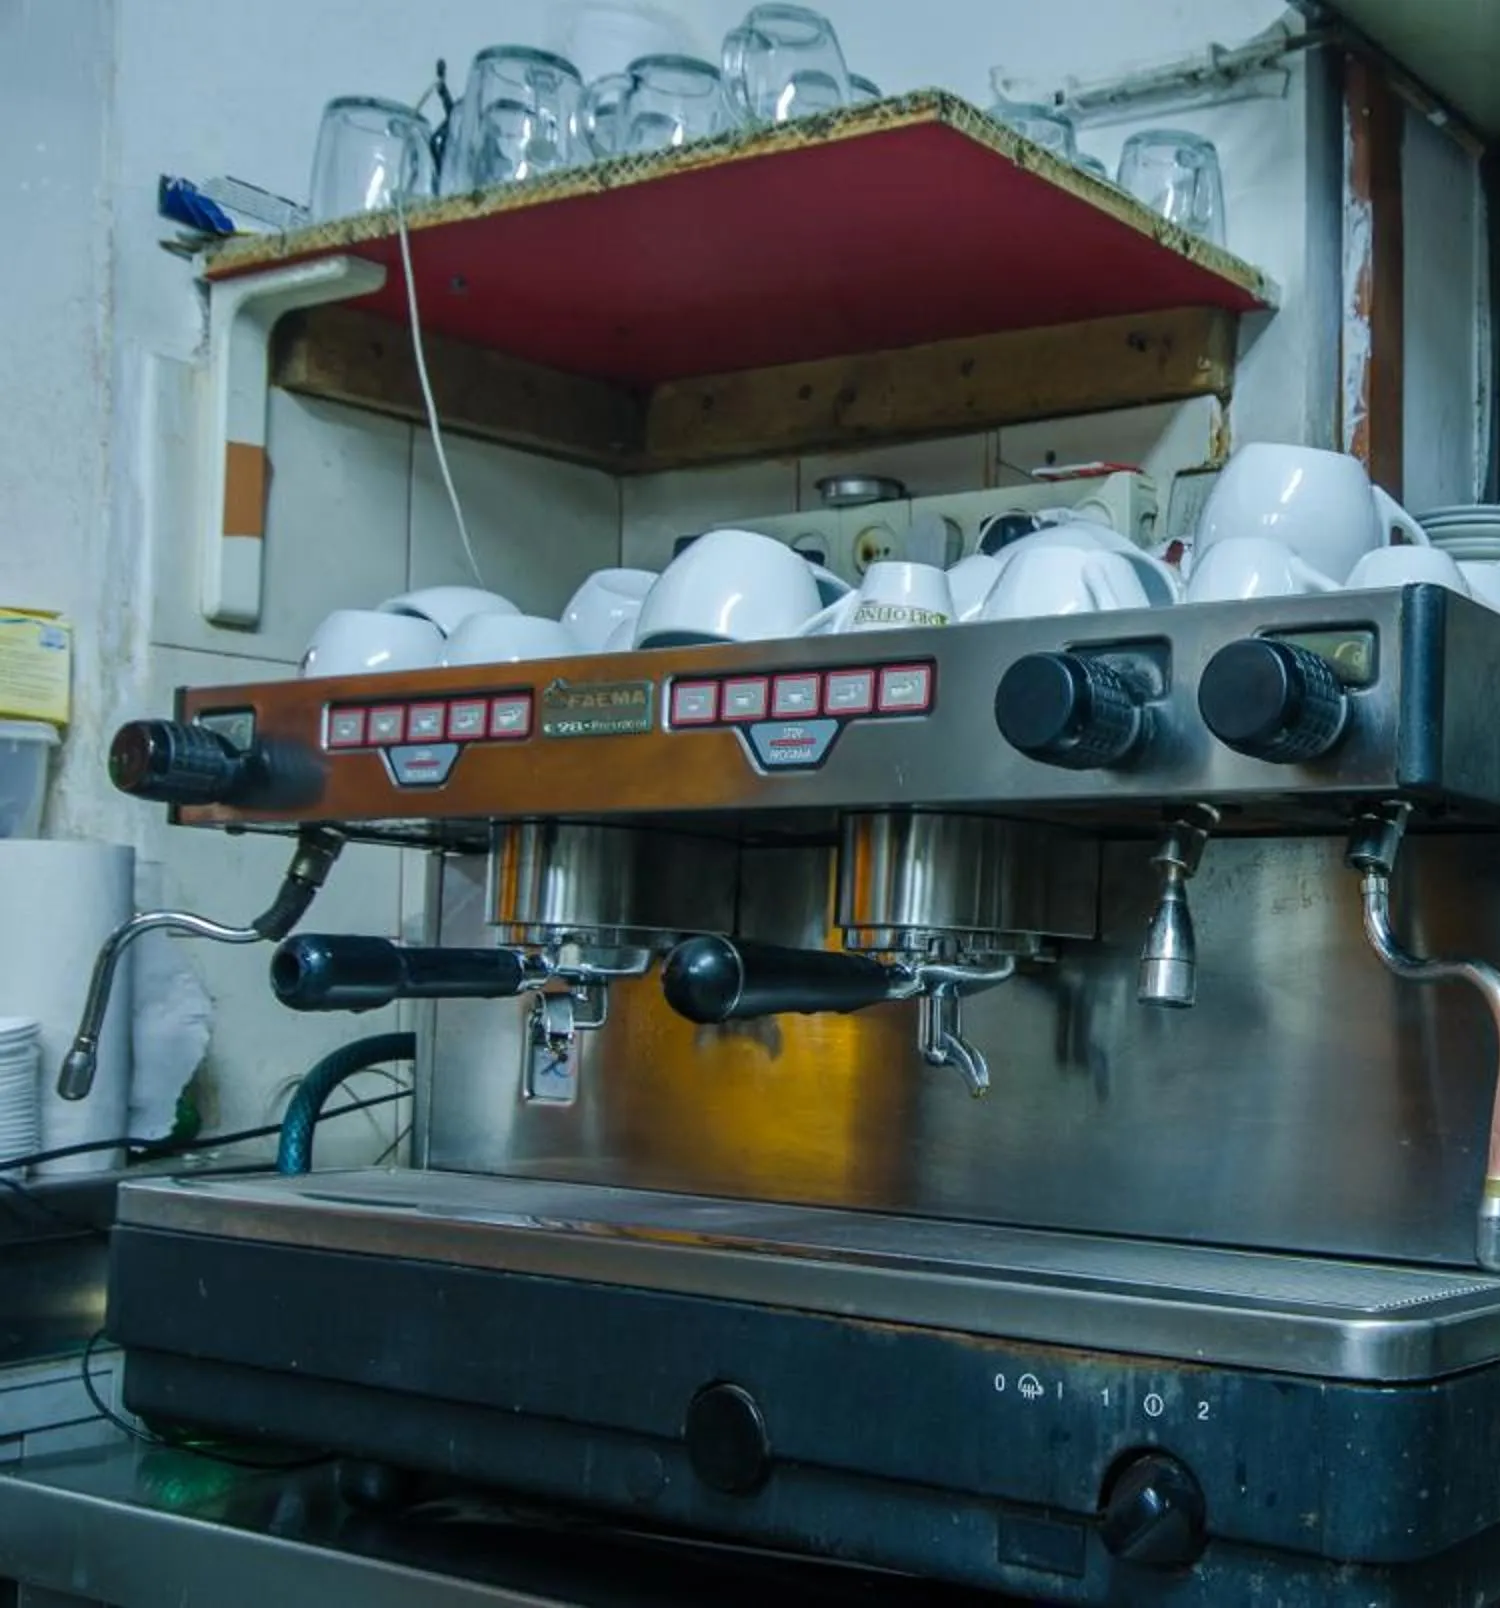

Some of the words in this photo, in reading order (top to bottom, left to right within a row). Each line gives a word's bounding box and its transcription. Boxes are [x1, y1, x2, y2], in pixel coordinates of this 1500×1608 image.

[567, 689, 646, 709] FAEMA
[1100, 1388, 1110, 1407] 1
[1197, 1401, 1210, 1420] 2
